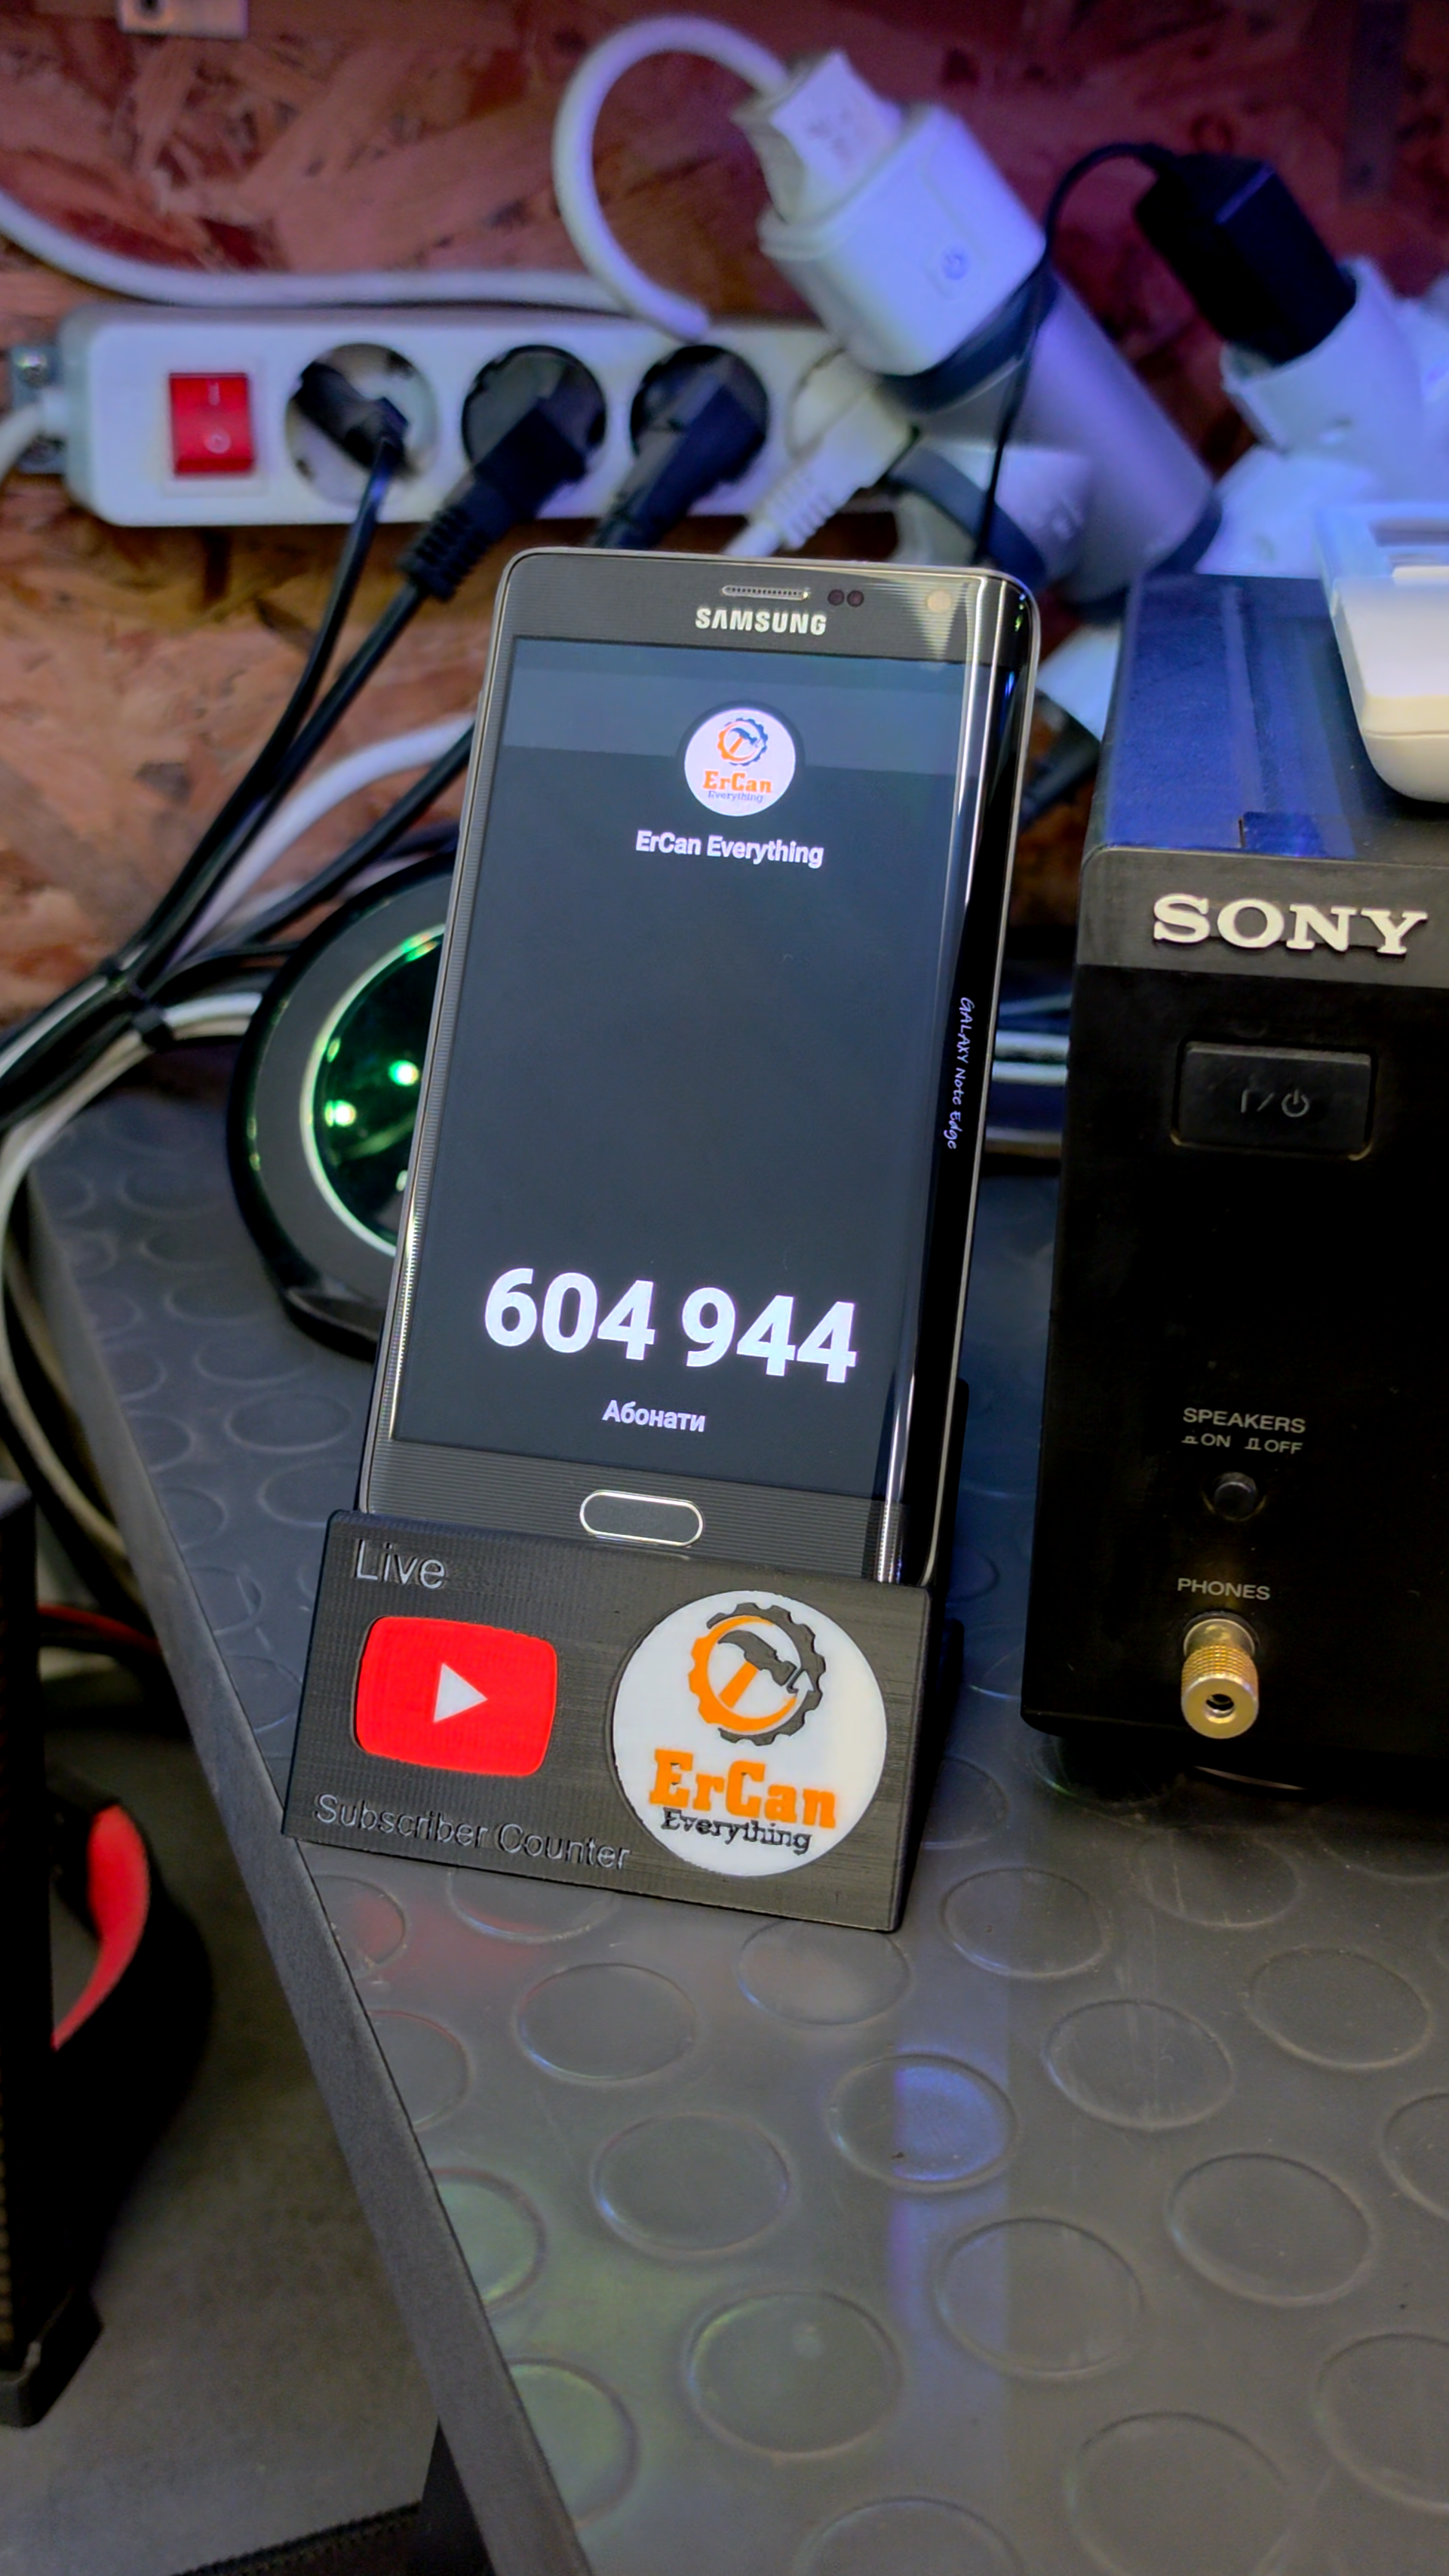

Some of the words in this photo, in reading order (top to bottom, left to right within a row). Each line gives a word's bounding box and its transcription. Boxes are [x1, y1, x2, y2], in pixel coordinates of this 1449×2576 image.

[695, 607, 827, 636] SAMSUNG
[702, 769, 772, 794] ErCan
[707, 790, 764, 804] Everything
[635, 829, 701, 856] ErCan
[706, 834, 824, 870] Everything
[1153, 892, 1429, 956] SONY
[956, 996, 975, 1064] GALAXY
[951, 1067, 966, 1106] Note
[943, 1110, 963, 1150] Edge
[484, 1267, 656, 1361] 604
[682, 1286, 858, 1383] 944
[601, 1399, 706, 1433] Абонати
[1182, 1407, 1306, 1434] SPEAKERS
[1200, 1432, 1231, 1448] ON
[1263, 1438, 1303, 1455] OFF
[354, 1538, 446, 1590] Live
[1177, 1577, 1271, 1601] PHONES
[649, 1748, 837, 1830] ErCan
[315, 1792, 488, 1849] Subscriber
[498, 1822, 631, 1870] Counter
[660, 1807, 812, 1856] Everything
